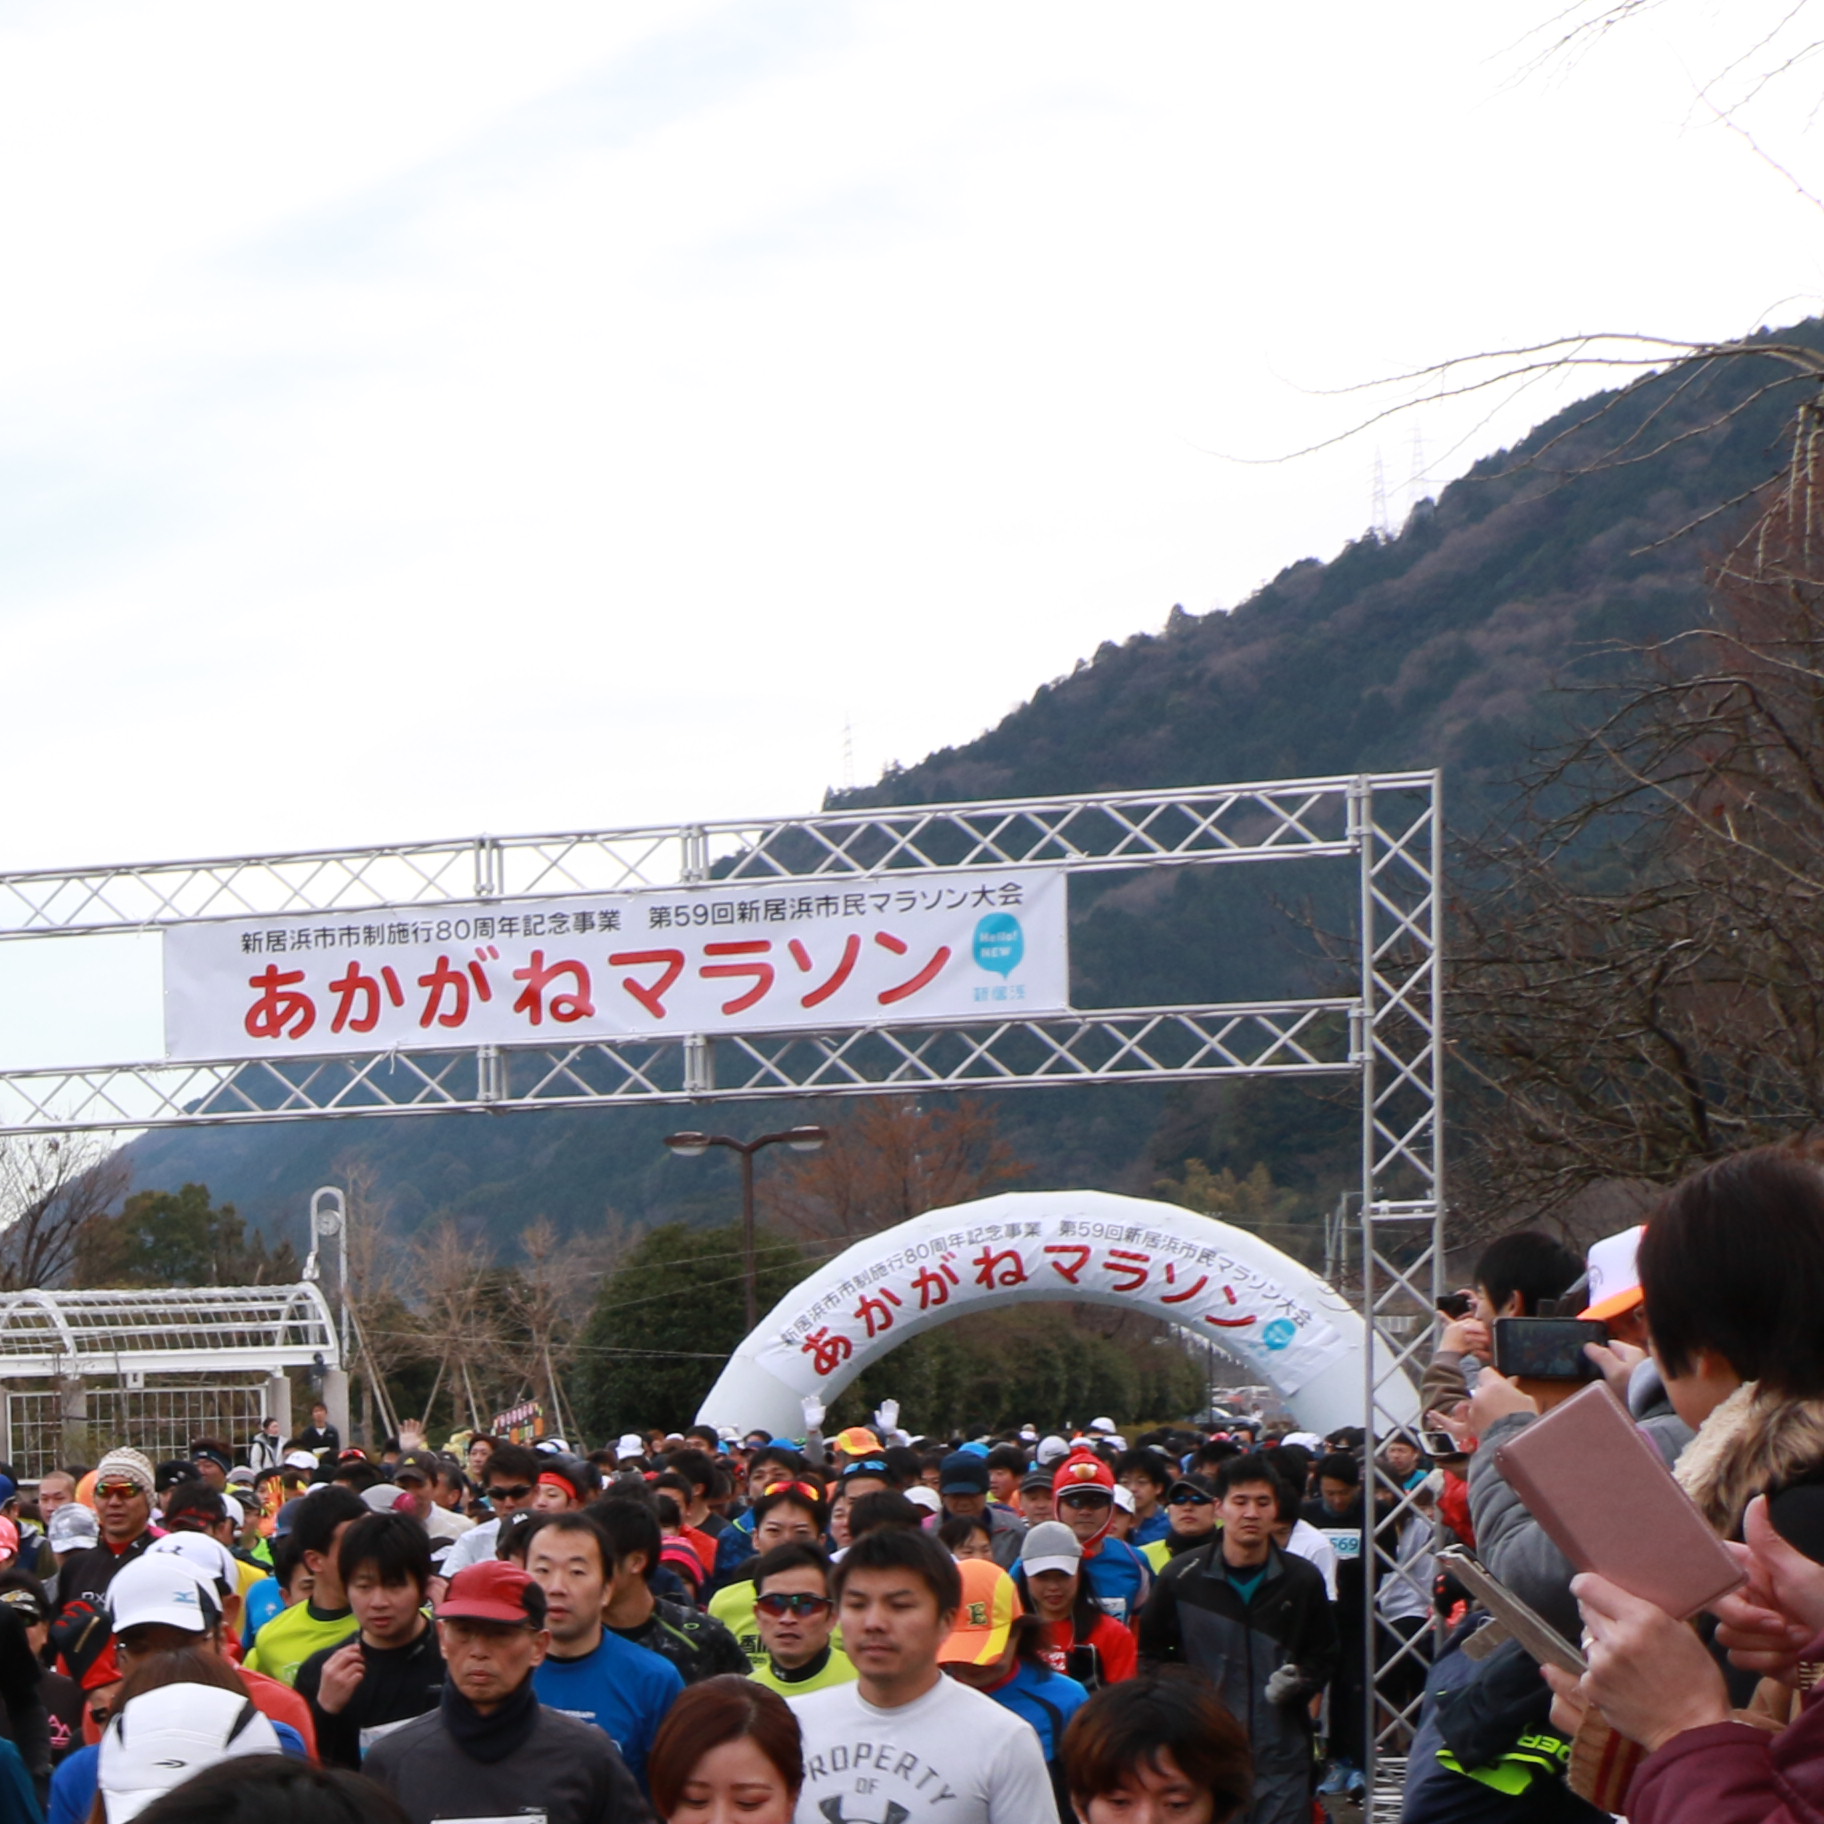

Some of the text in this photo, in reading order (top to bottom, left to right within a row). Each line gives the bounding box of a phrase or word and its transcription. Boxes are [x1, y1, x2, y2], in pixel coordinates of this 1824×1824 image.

[241, 880, 1024, 954] 新居浜市市制施行80周年記念事業 第59回新居浜市民マラソン大会
[244, 930, 952, 1041] あかがねマラソン
[779, 1219, 1314, 1348] 新居浜市市制施行80周年記念事業 第59回新居浜市民マラソン大会
[802, 1244, 1257, 1376] あかがねマラソン
[806, 1742, 958, 1805] ROPERTY
[855, 1776, 880, 1795] OF
